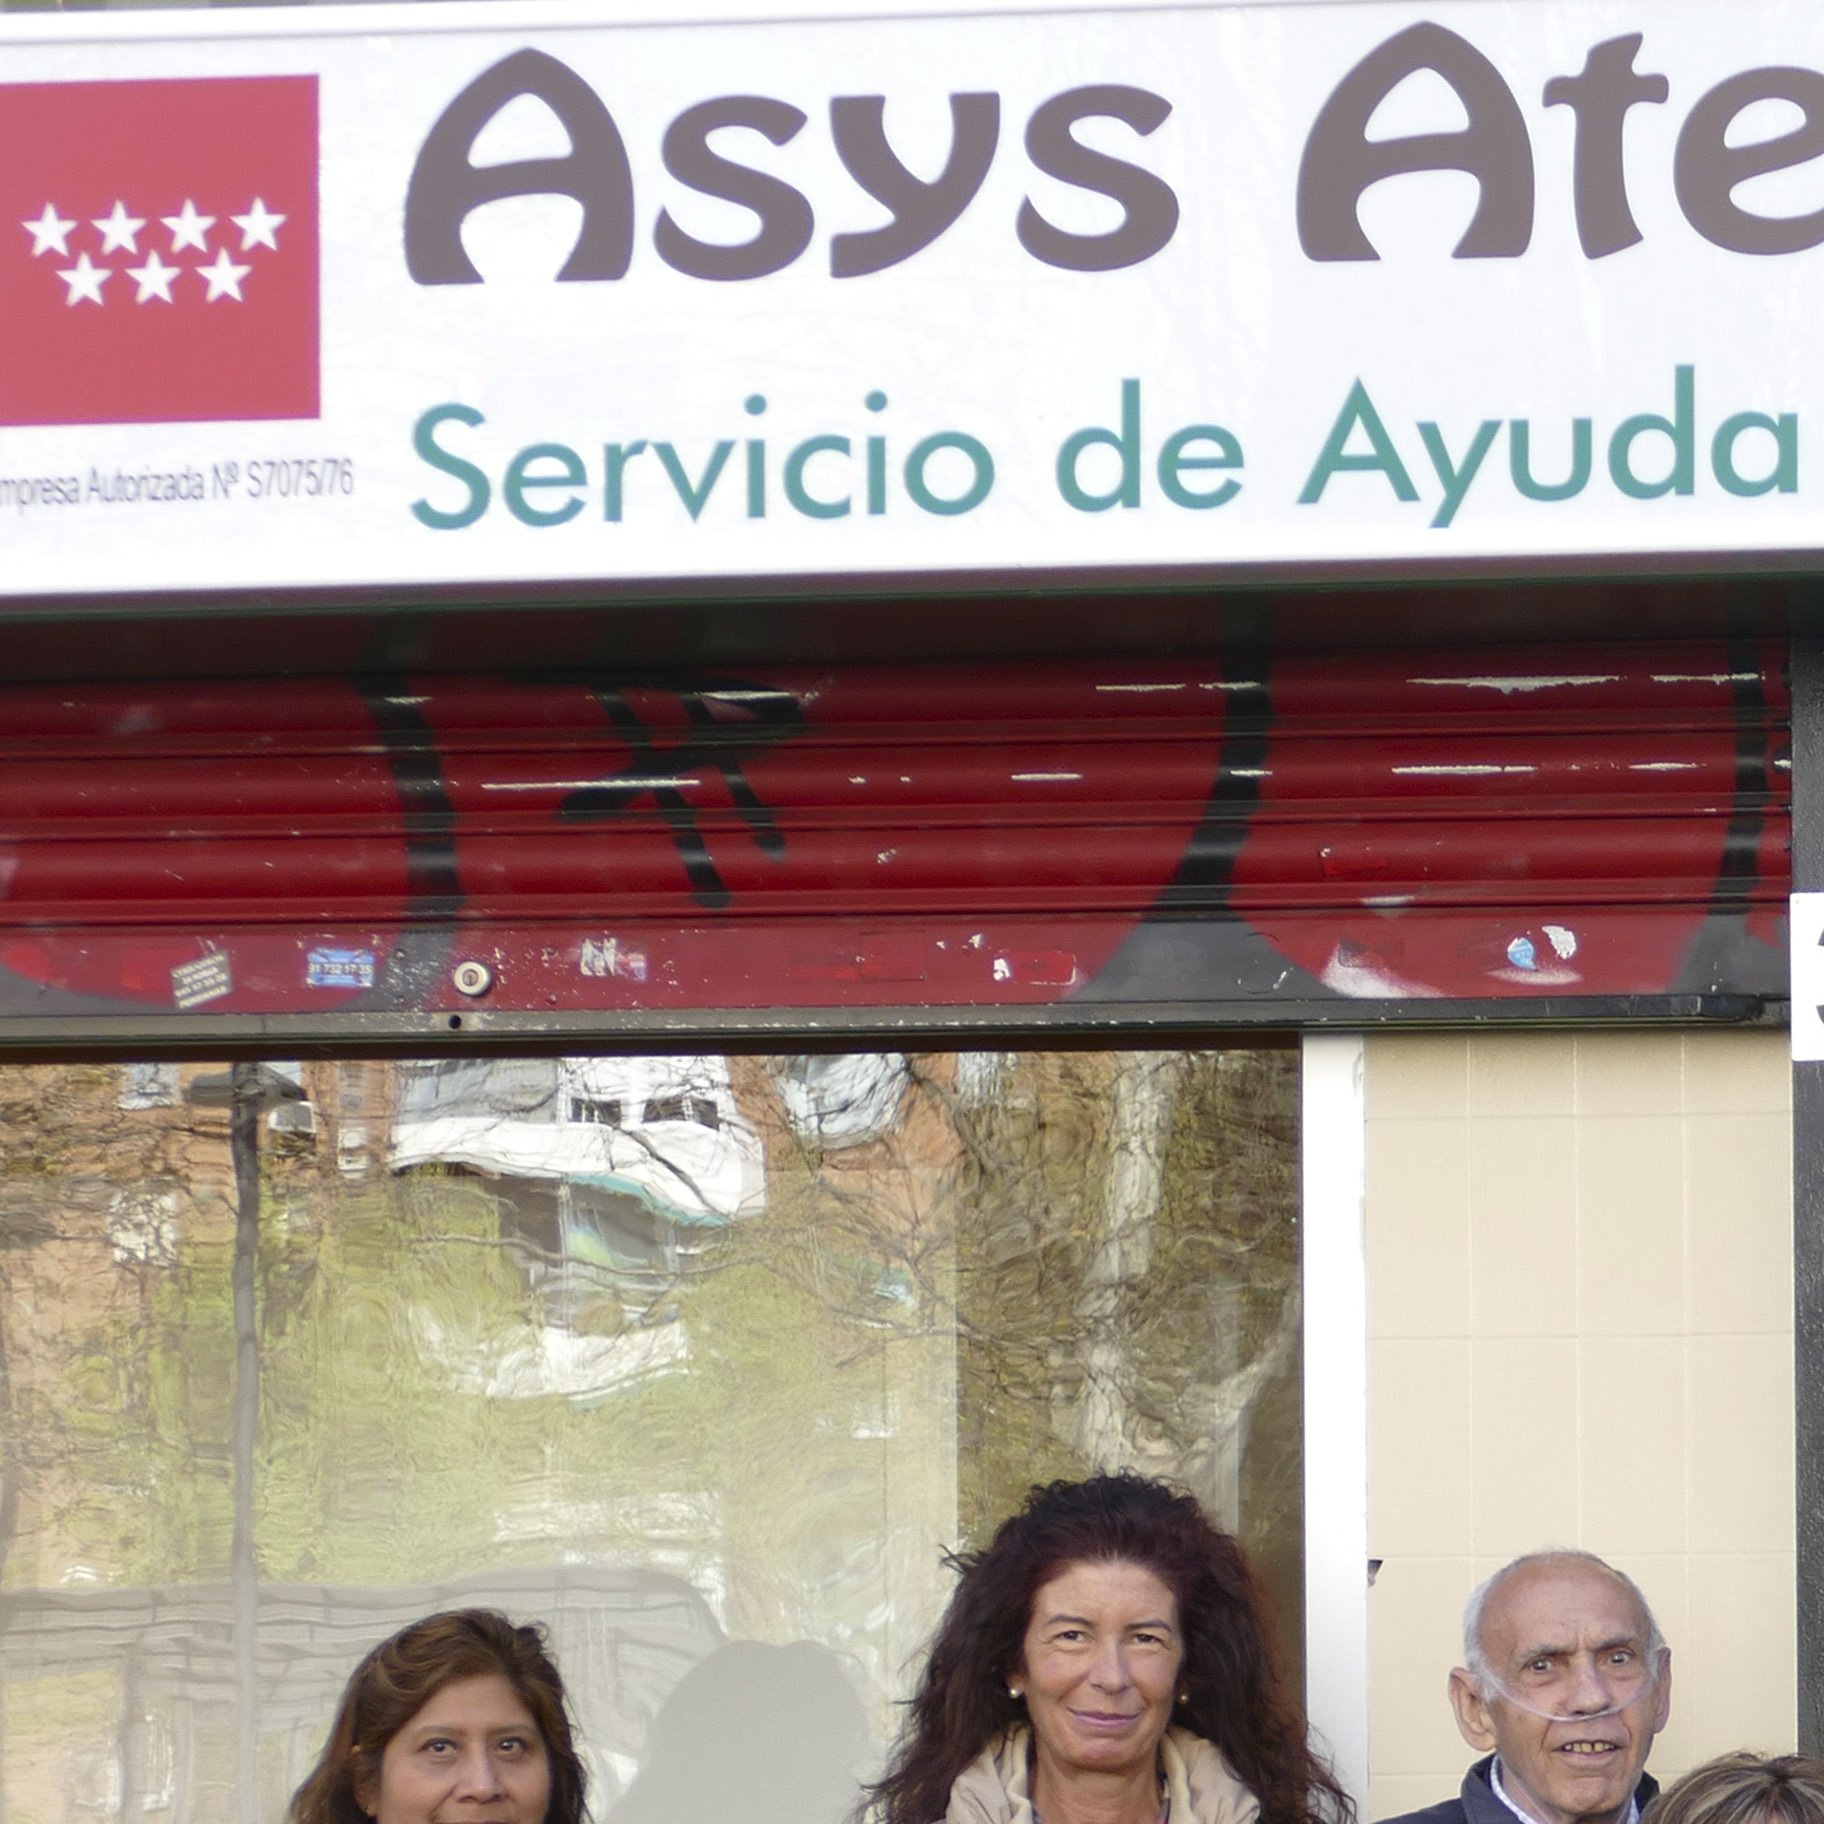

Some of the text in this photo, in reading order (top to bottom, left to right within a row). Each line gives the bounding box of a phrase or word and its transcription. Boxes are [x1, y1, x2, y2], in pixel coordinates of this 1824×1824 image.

[403, 48, 1179, 285] Asys
[90, 464, 204, 501] Autorizada
[248, 458, 354, 498] S7075/76
[413, 391, 994, 529] Servicio
[1057, 379, 1243, 512] de
[1299, 365, 1797, 528] Ayuda
